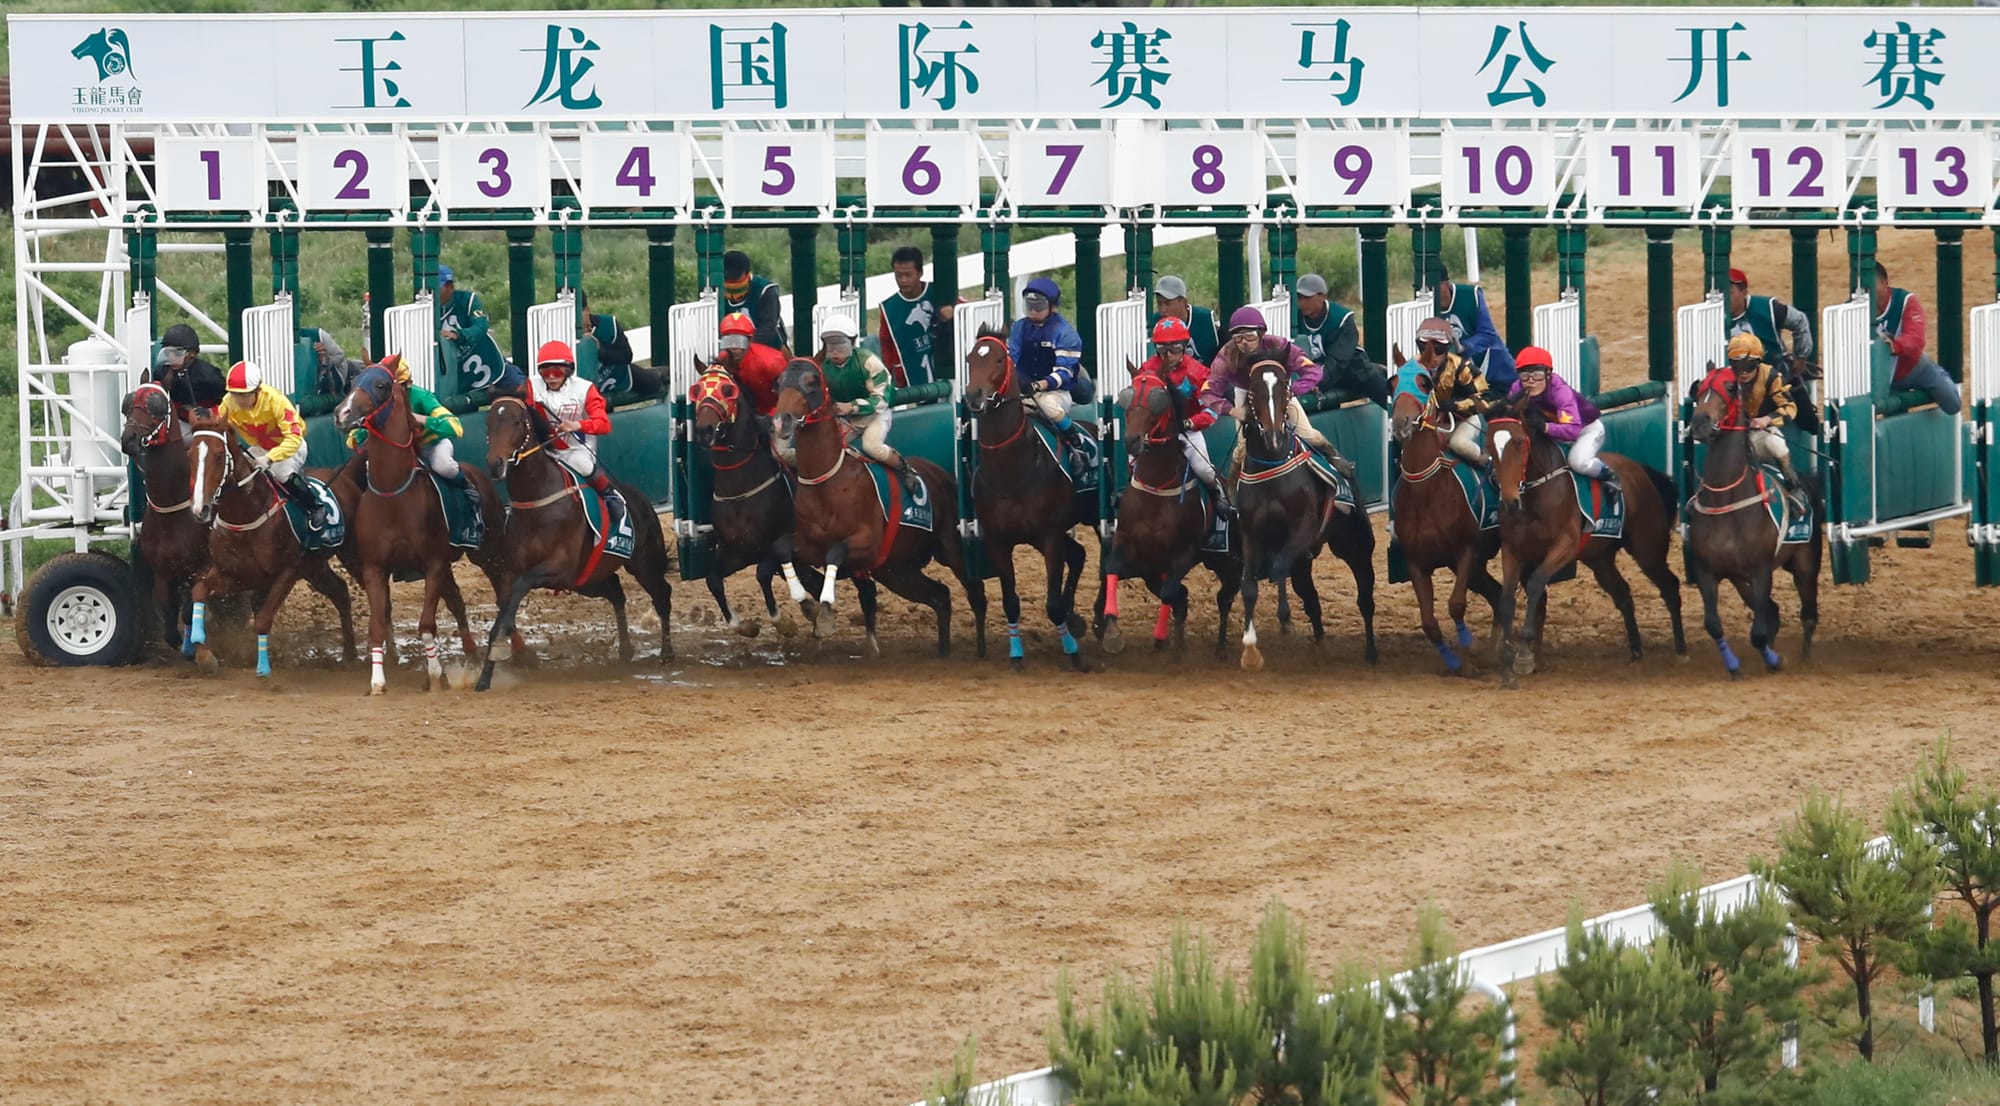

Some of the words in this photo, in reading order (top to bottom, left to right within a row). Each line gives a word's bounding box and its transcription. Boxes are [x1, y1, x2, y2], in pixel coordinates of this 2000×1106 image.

[331, 19, 1946, 110] 玉龙国际赛马公开赛
[72, 86, 142, 105] 玉龍馬會
[200, 151, 220, 200] 1
[334, 150, 370, 199] 2
[477, 149, 512, 198] 3
[615, 146, 656, 196] 4
[762, 147, 795, 195] 5
[902, 146, 941, 195] 6
[1046, 146, 1082, 194] 7
[1191, 145, 1225, 194] 8
[1333, 145, 1373, 195] 9
[1461, 146, 1533, 195] 10
[1610, 145, 1675, 196] 11
[1750, 146, 1825, 197] 12
[1898, 146, 1969, 196] 13
[462, 354, 491, 388] 3
